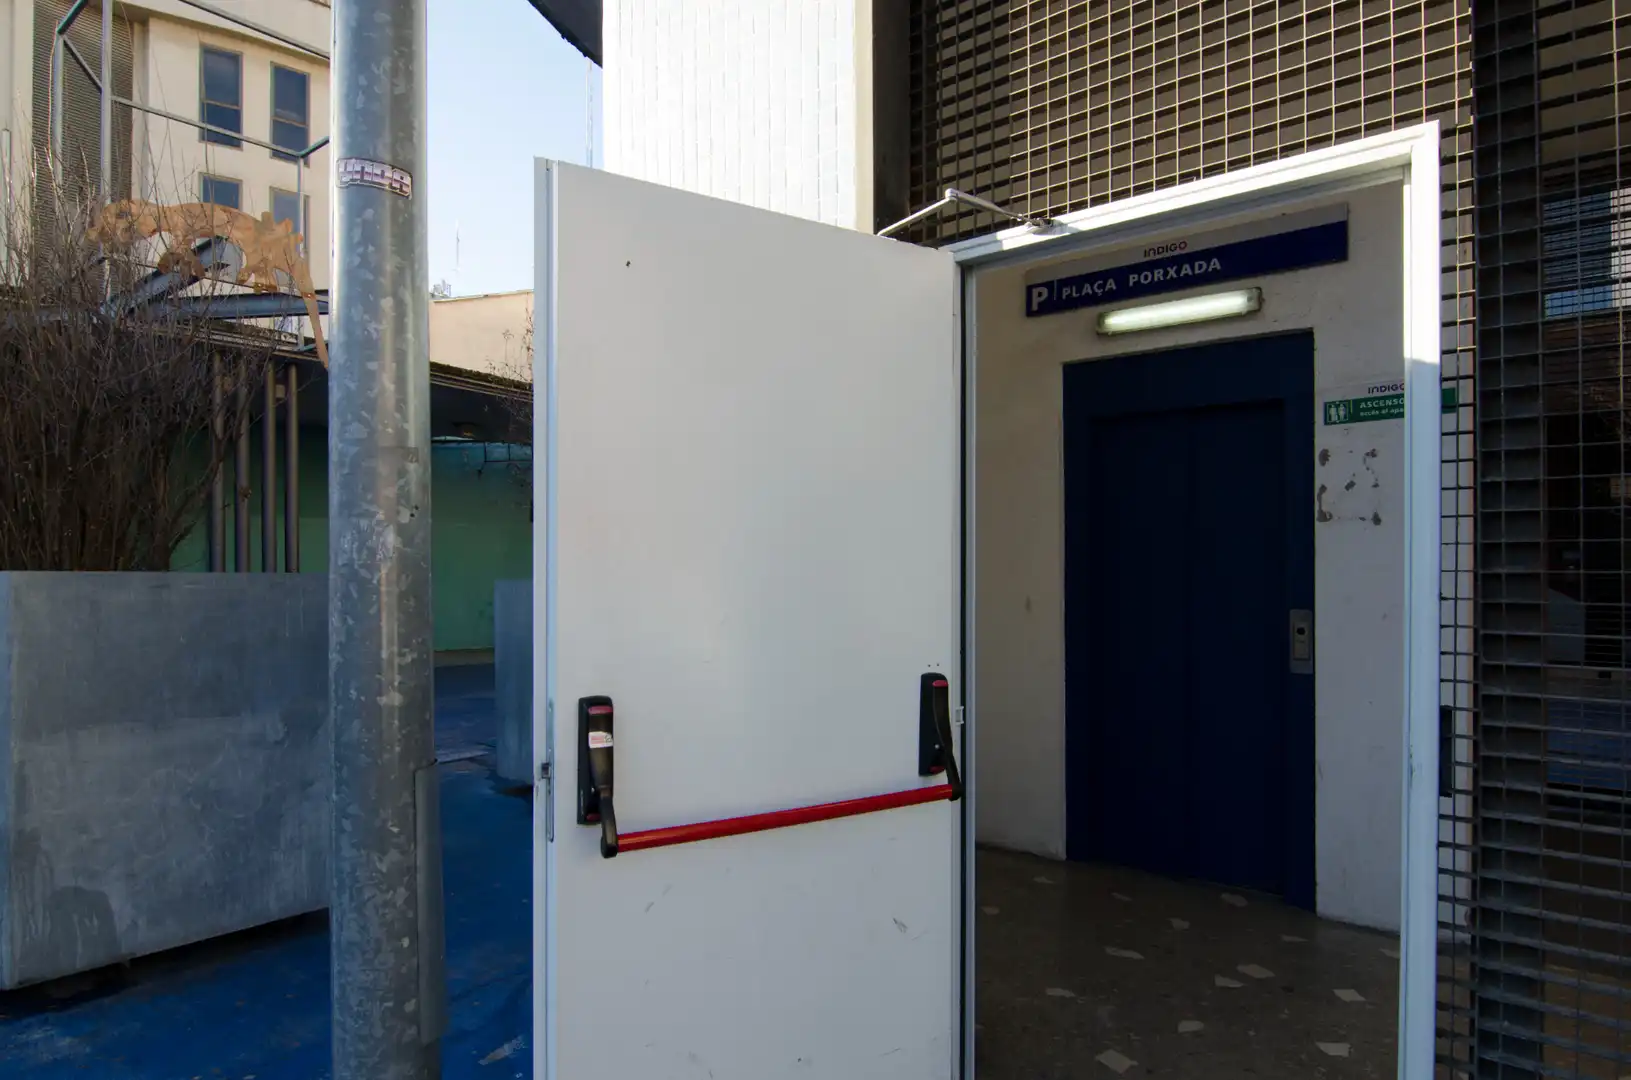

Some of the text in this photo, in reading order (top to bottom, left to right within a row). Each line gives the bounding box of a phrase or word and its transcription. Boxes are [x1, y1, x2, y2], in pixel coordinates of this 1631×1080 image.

[1144, 240, 1188, 258] INDIGO
[1031, 257, 1222, 311] P PLAÇA PORXADA
[1360, 398, 1404, 408] ASCENSO
